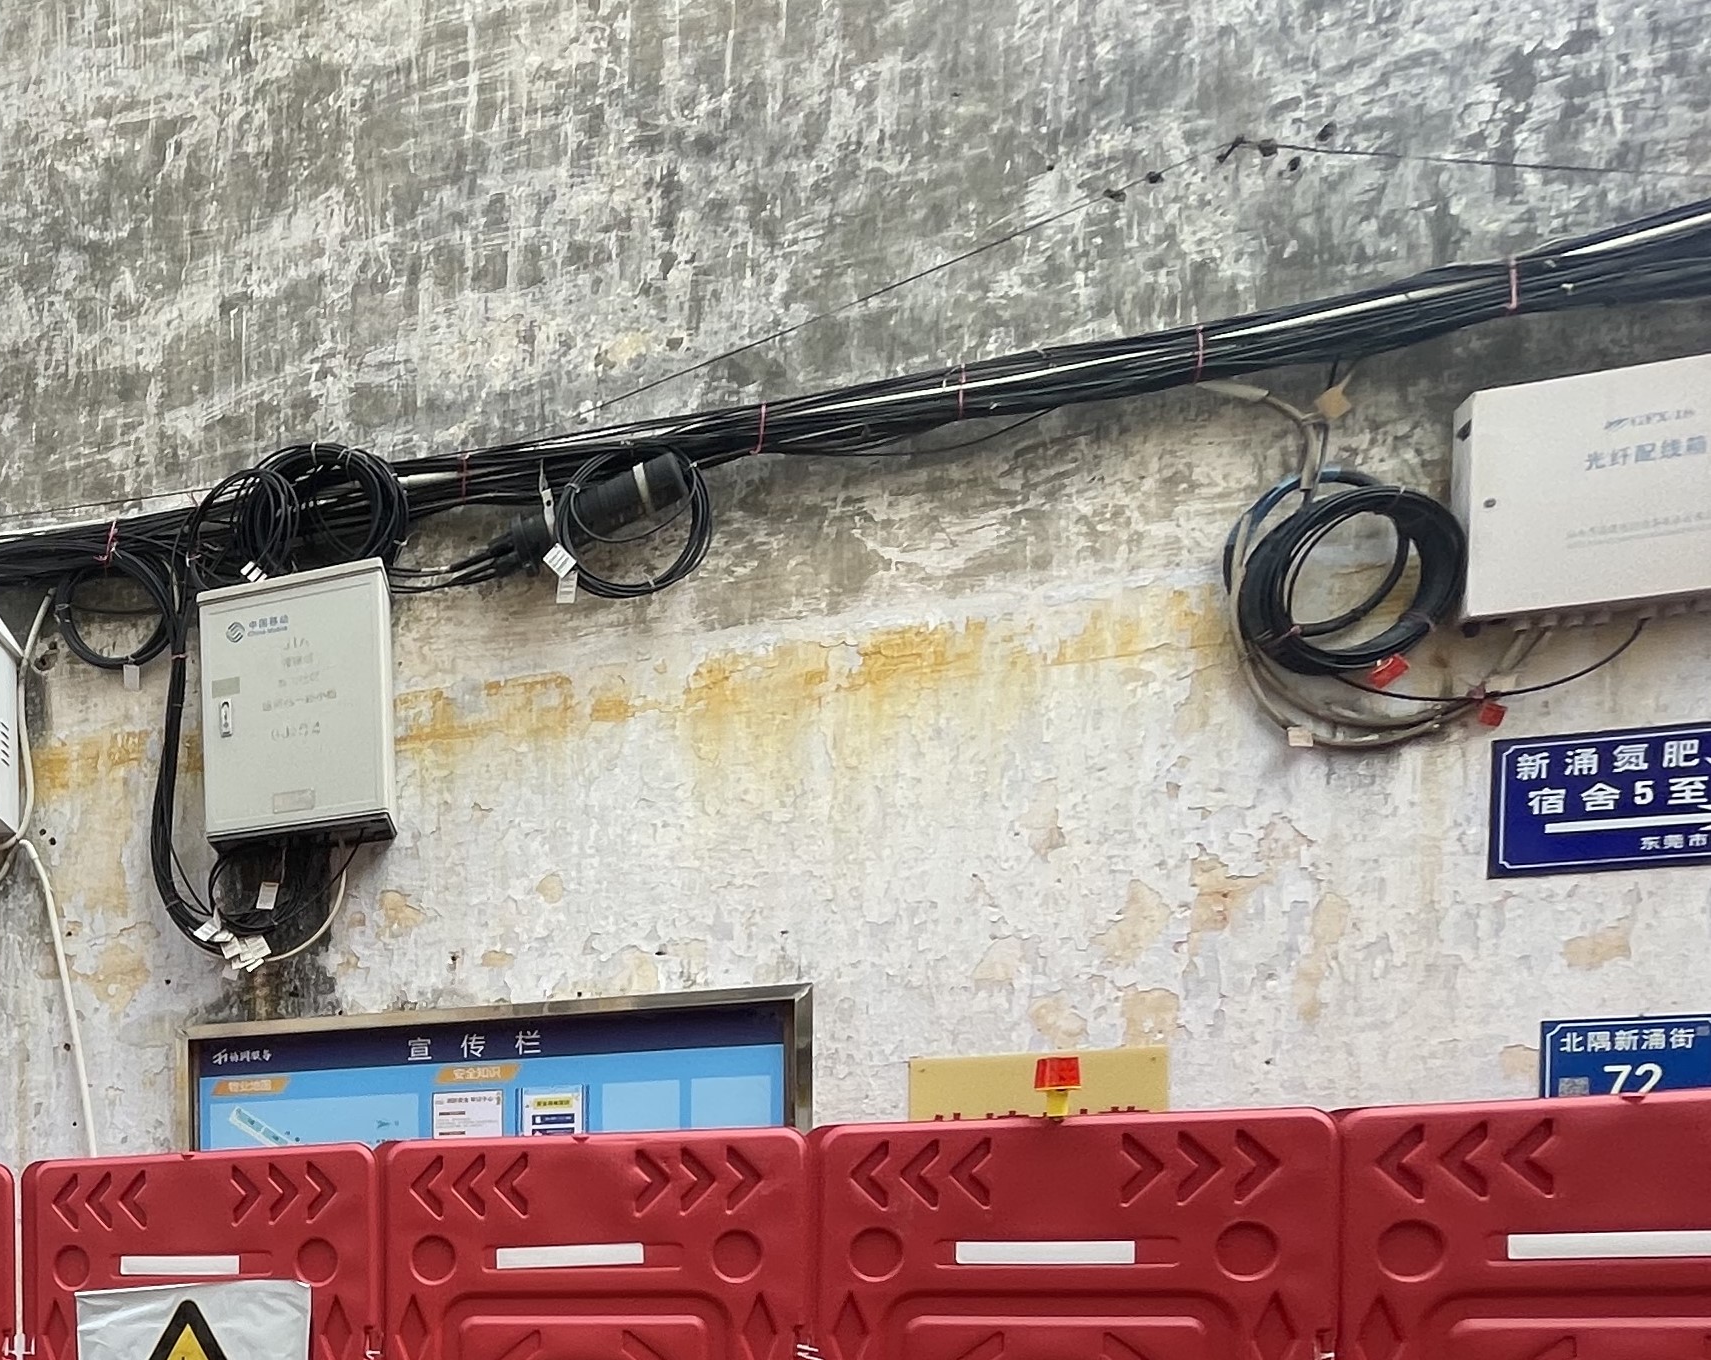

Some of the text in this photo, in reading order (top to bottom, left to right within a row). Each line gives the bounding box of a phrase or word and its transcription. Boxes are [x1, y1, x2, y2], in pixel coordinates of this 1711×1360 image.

[249, 614, 289, 629] 中国移动
[1528, 776, 1709, 815] 宿舍5至
[1640, 833, 1708, 850] 东莞市
[407, 1030, 542, 1061] 宣传栏
[1560, 1028, 1695, 1053] 北隅新涌街
[452, 1066, 501, 1080] 安全知识
[1604, 1063, 1663, 1095] 72
